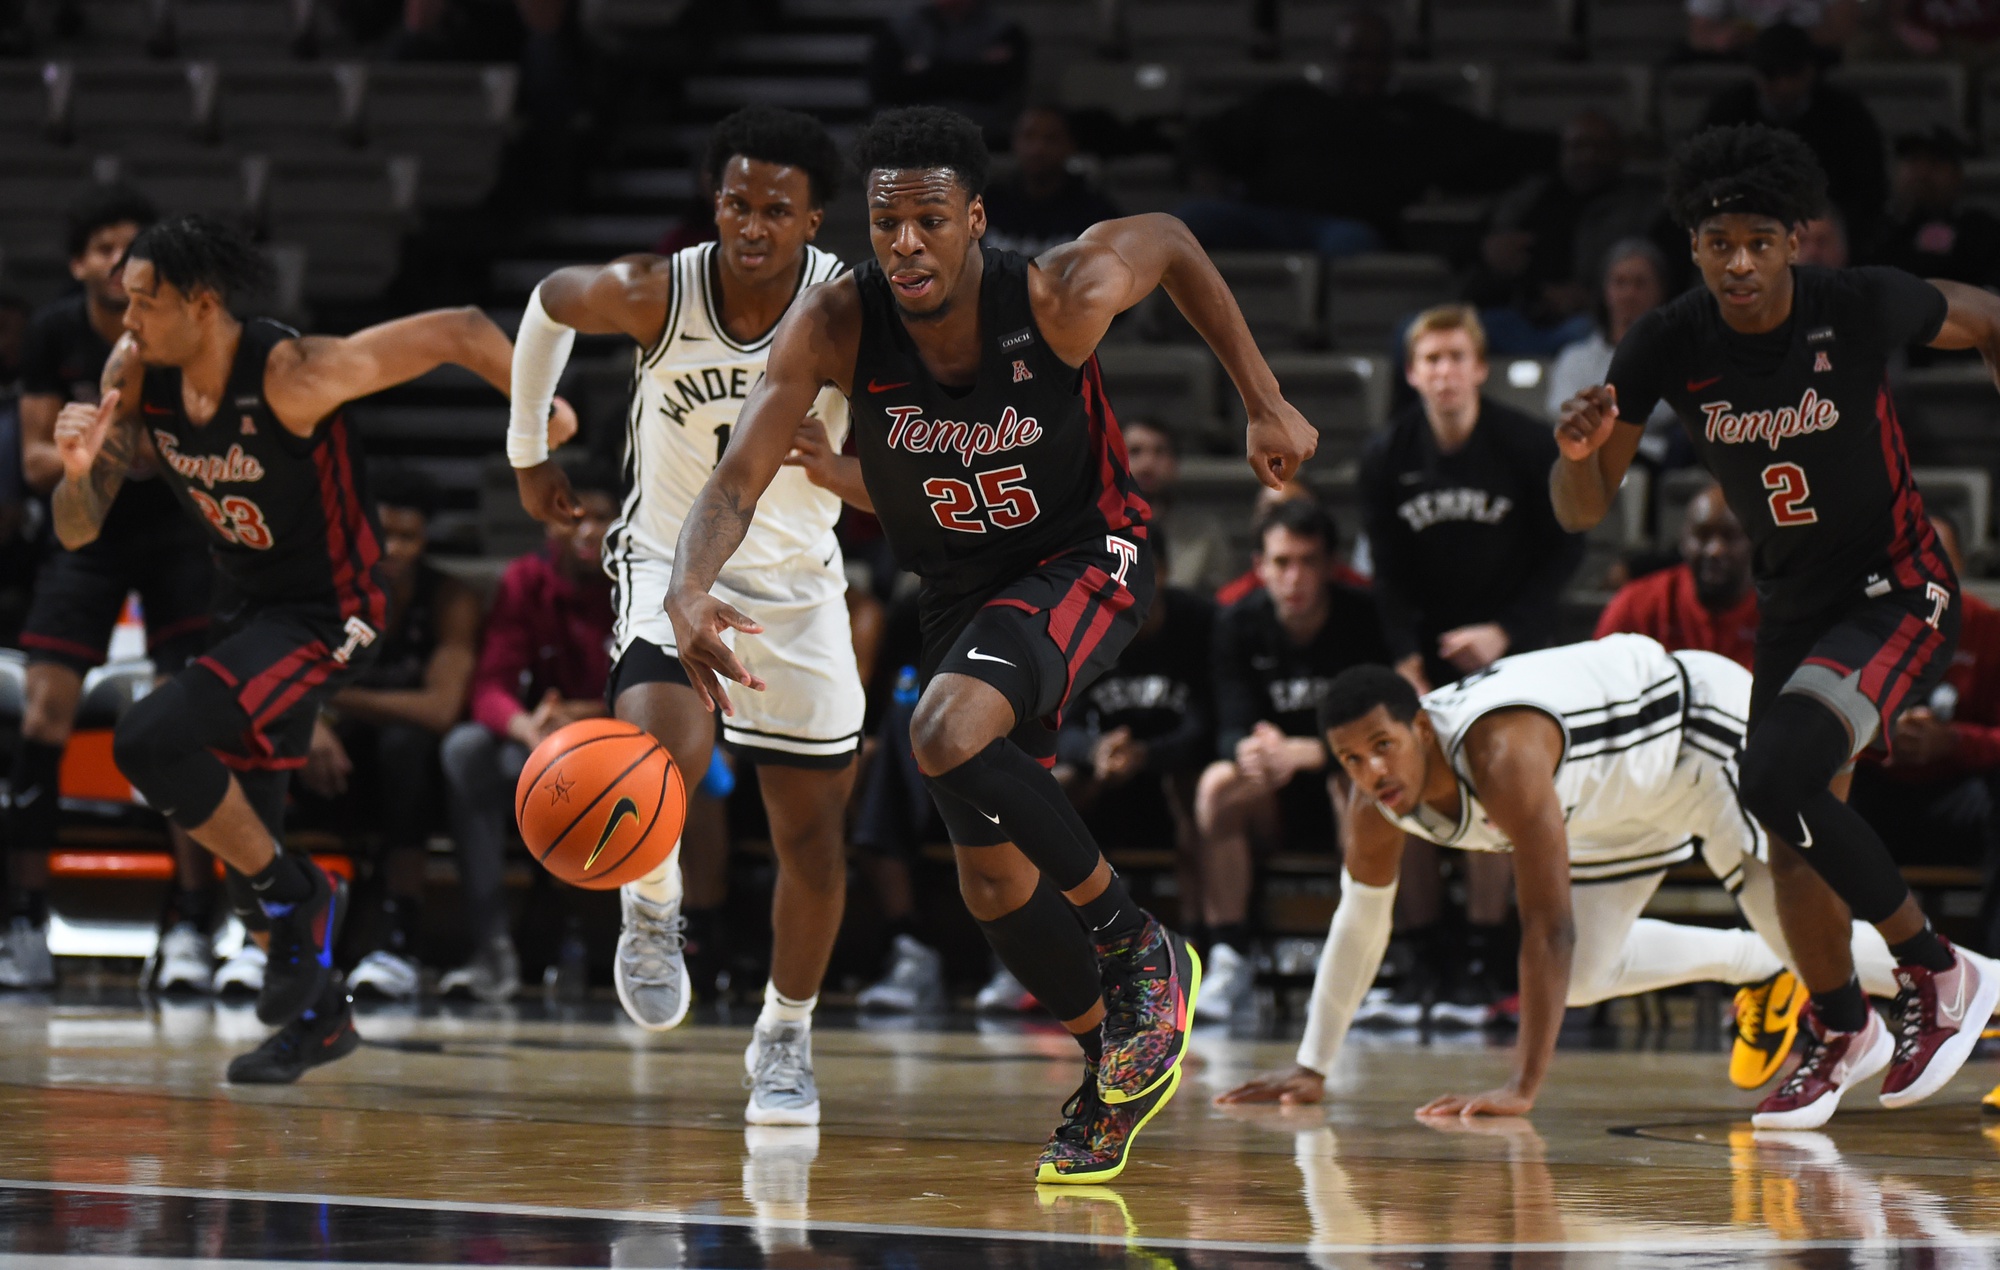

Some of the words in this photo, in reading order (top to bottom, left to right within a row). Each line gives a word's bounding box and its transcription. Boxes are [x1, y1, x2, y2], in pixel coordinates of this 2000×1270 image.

[1001, 333, 1031, 348] COACH
[885, 406, 1043, 468] Temple
[1700, 388, 1840, 451] Temple
[922, 463, 1041, 534] 25
[1761, 461, 1818, 527] 2
[1105, 534, 1138, 587] T
[1925, 581, 1951, 630] T
[332, 615, 377, 664] T
